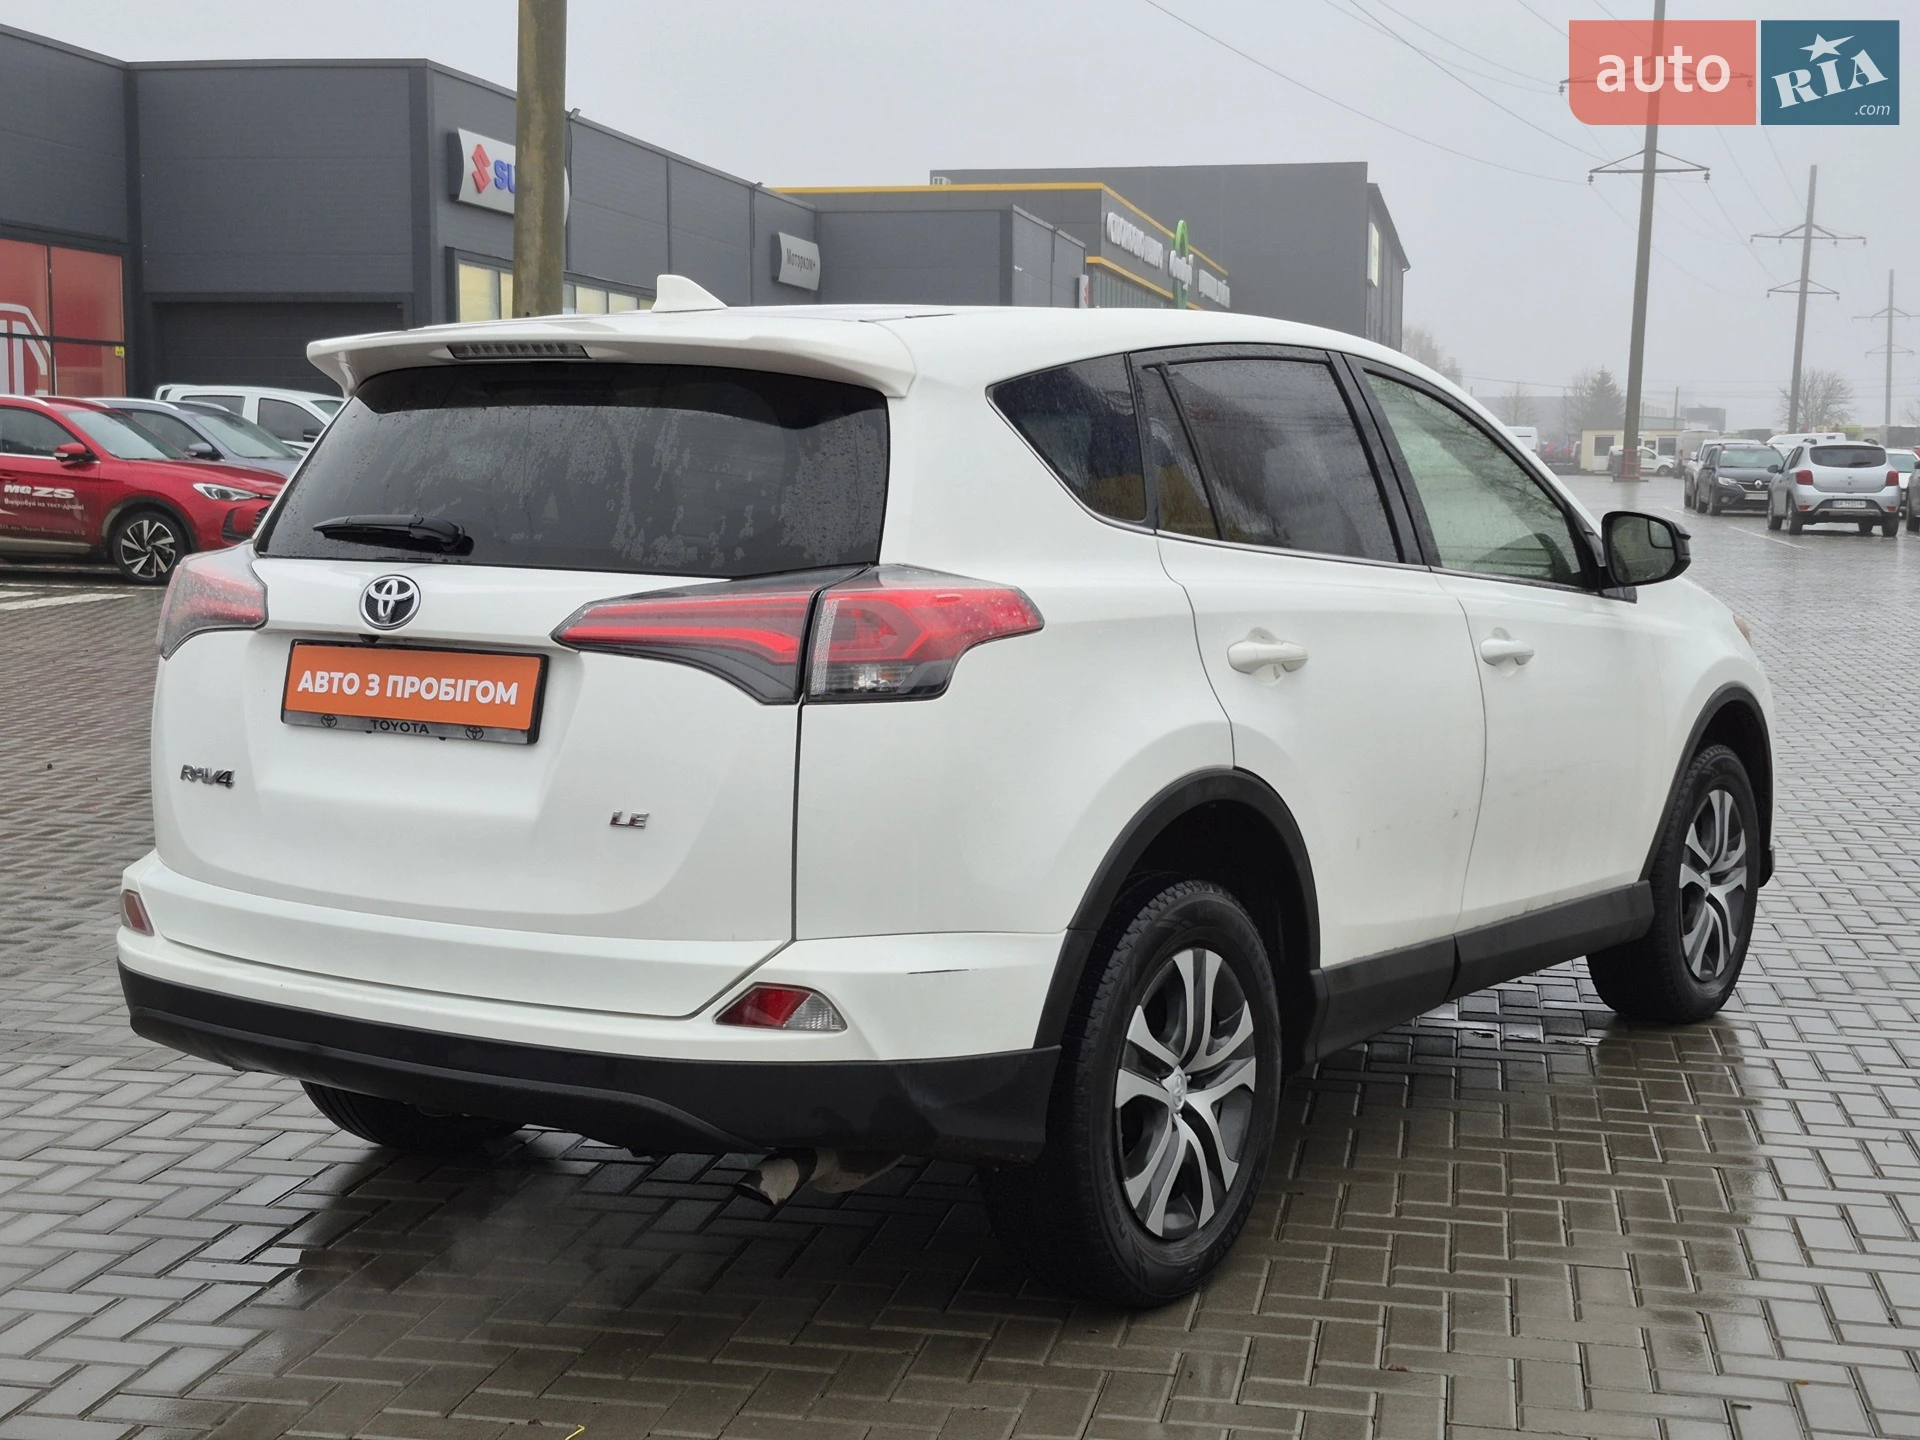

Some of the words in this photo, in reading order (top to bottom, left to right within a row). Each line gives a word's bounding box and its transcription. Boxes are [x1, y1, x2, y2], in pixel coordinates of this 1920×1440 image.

[32, 486, 75, 498] ZS
[297, 670, 360, 695] АВТО
[386, 674, 519, 706] ПРОБІГОМ
[370, 719, 430, 735] TOYOTA
[180, 764, 235, 789] RAV4
[610, 810, 650, 830] LE
